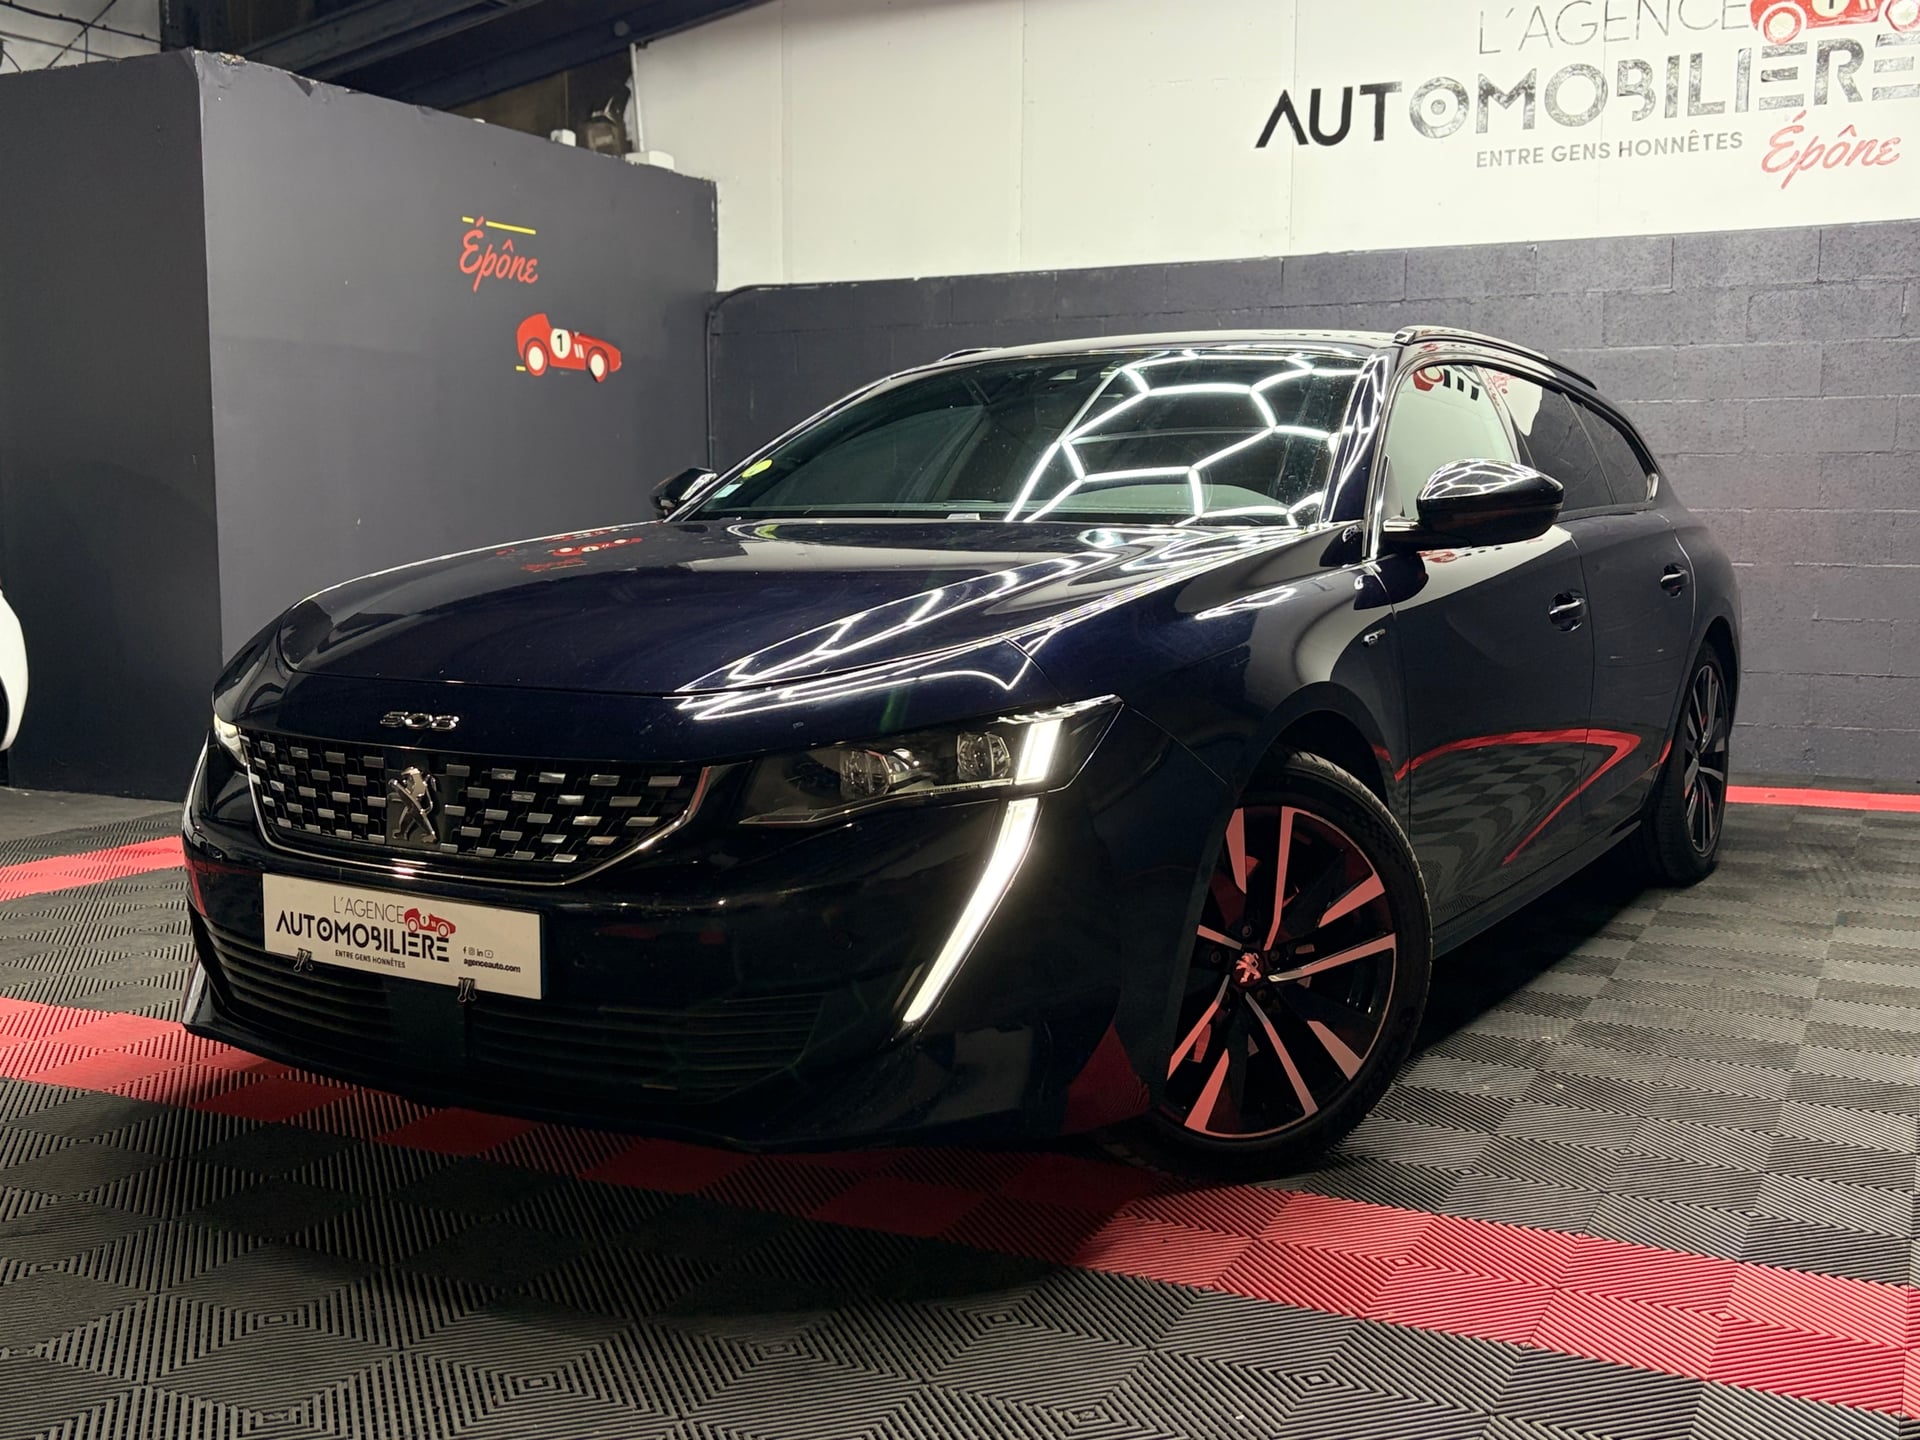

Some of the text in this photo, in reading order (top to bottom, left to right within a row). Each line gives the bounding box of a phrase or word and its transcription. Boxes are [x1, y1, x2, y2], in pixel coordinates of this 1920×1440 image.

[1479, 0, 1750, 54] L'AGENCE
[1255, 31, 1920, 148] AUTOMOBILIERE
[1476, 129, 1743, 168] ENTRE GENS HONNÊTES
[1761, 110, 1901, 189] Épône
[459, 216, 539, 293] Épône
[556, 333, 564, 353] 1
[380, 711, 460, 731] 508
[333, 895, 405, 925] L'AGENCE
[276, 910, 450, 963] AUTOMOBILIERE
[335, 949, 354, 960] ENTRE
[355, 953, 371, 963] GENS
[463, 958, 521, 973] agenceauto.com
